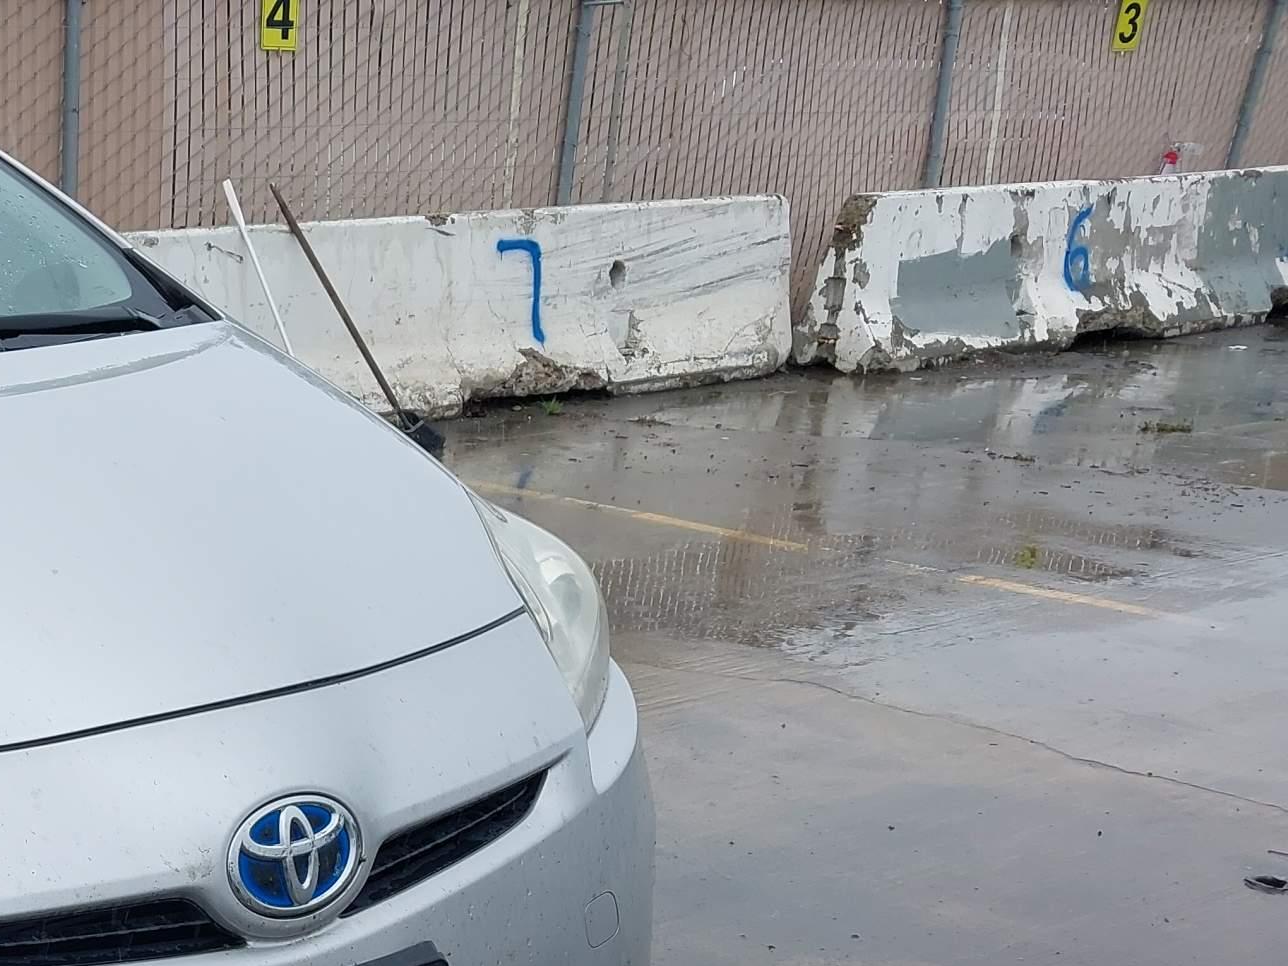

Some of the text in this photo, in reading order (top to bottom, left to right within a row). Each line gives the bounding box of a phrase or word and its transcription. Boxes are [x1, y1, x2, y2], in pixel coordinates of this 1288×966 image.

[266, 0, 295, 40] 4
[1118, 2, 1141, 44] 3
[1063, 202, 1095, 292] 6
[496, 238, 546, 345] 7
